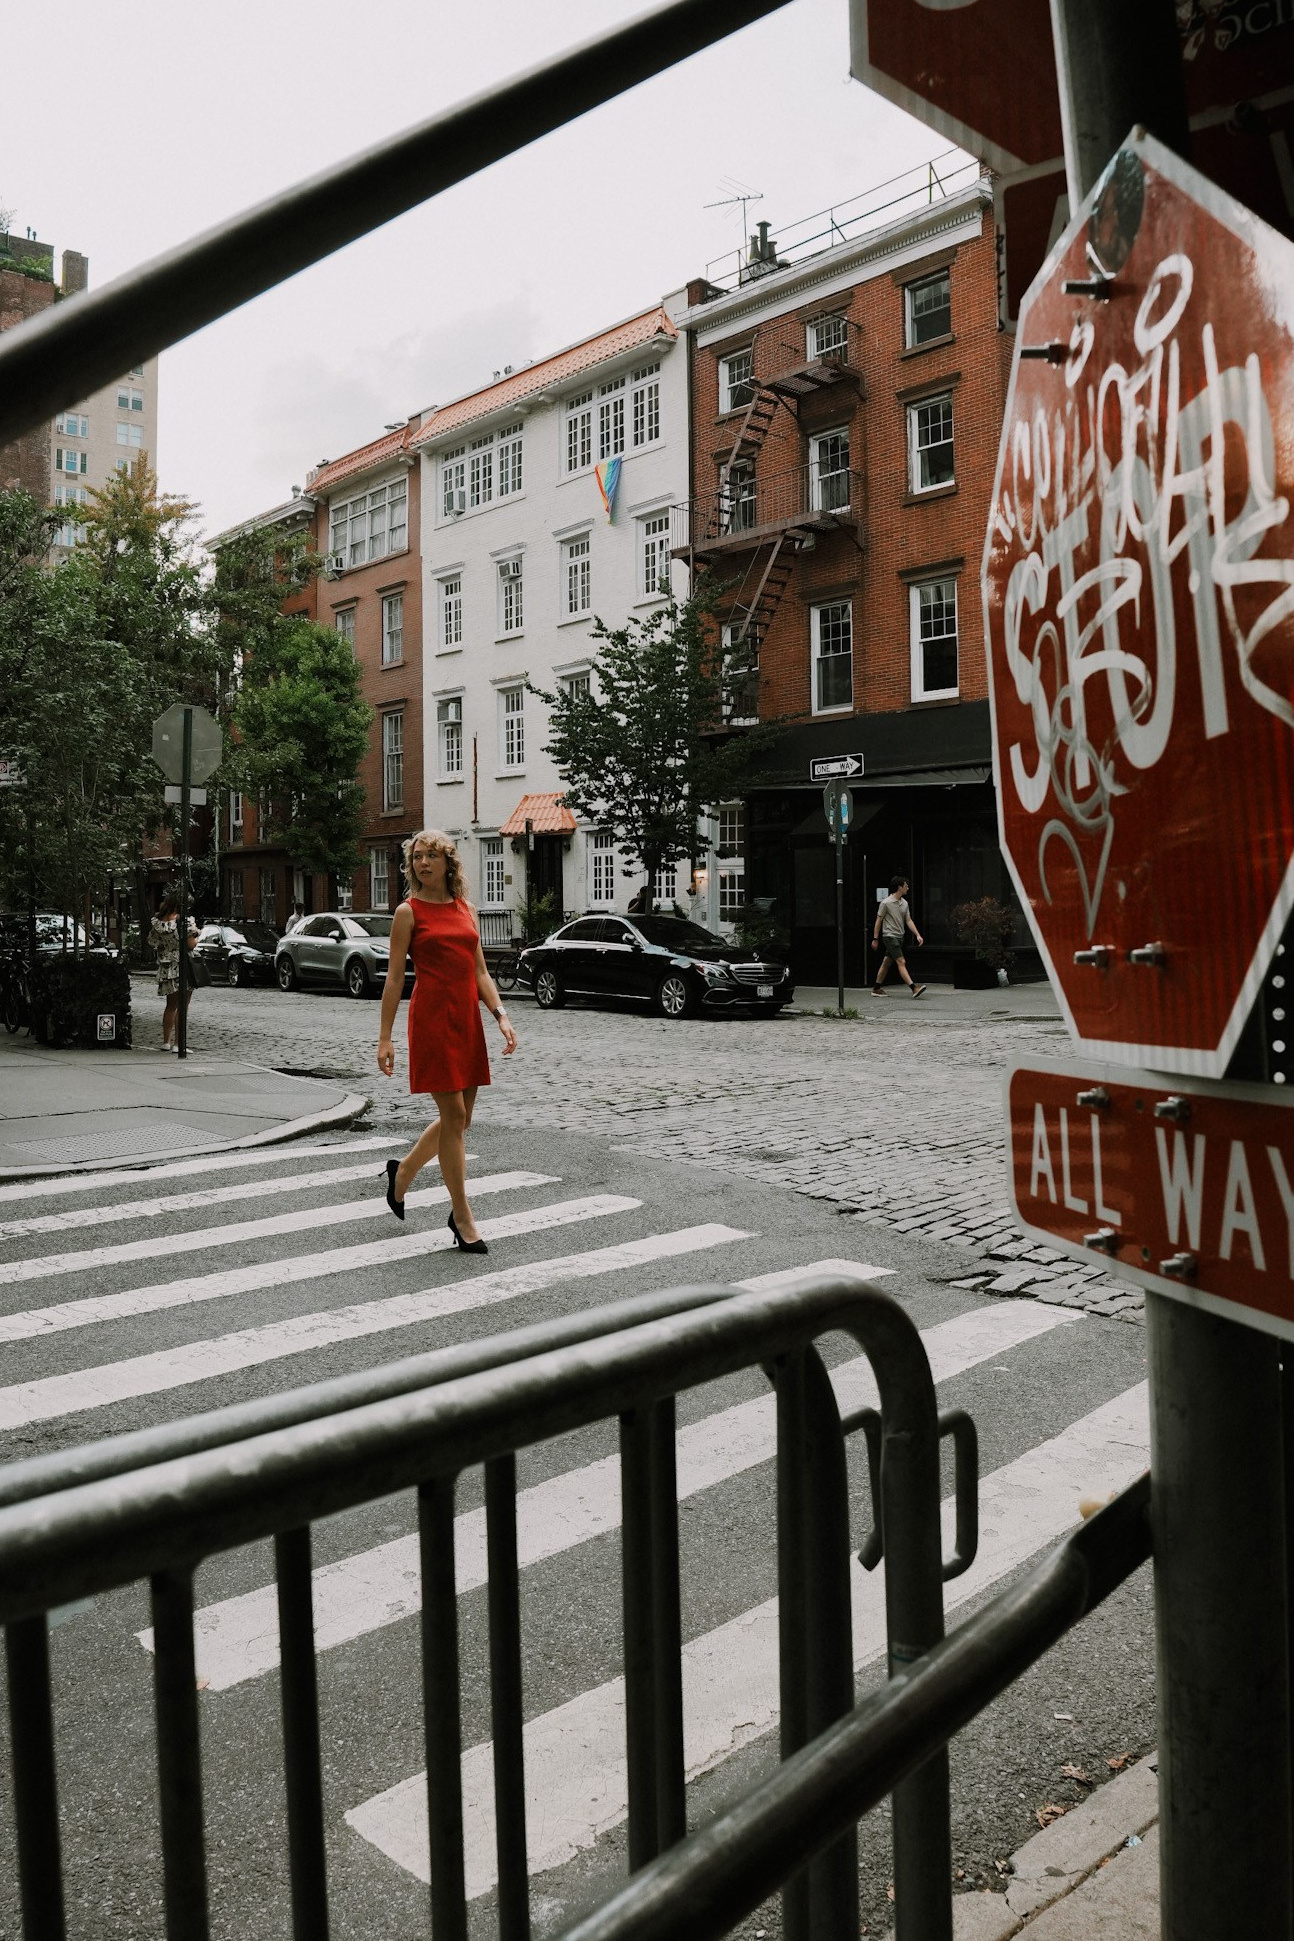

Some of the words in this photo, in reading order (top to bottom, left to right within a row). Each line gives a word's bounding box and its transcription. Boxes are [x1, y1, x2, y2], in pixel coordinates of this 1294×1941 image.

[816, 764, 831, 774] ONE
[839, 761, 854, 771] WAY
[1030, 1102, 1122, 1227] ALL
